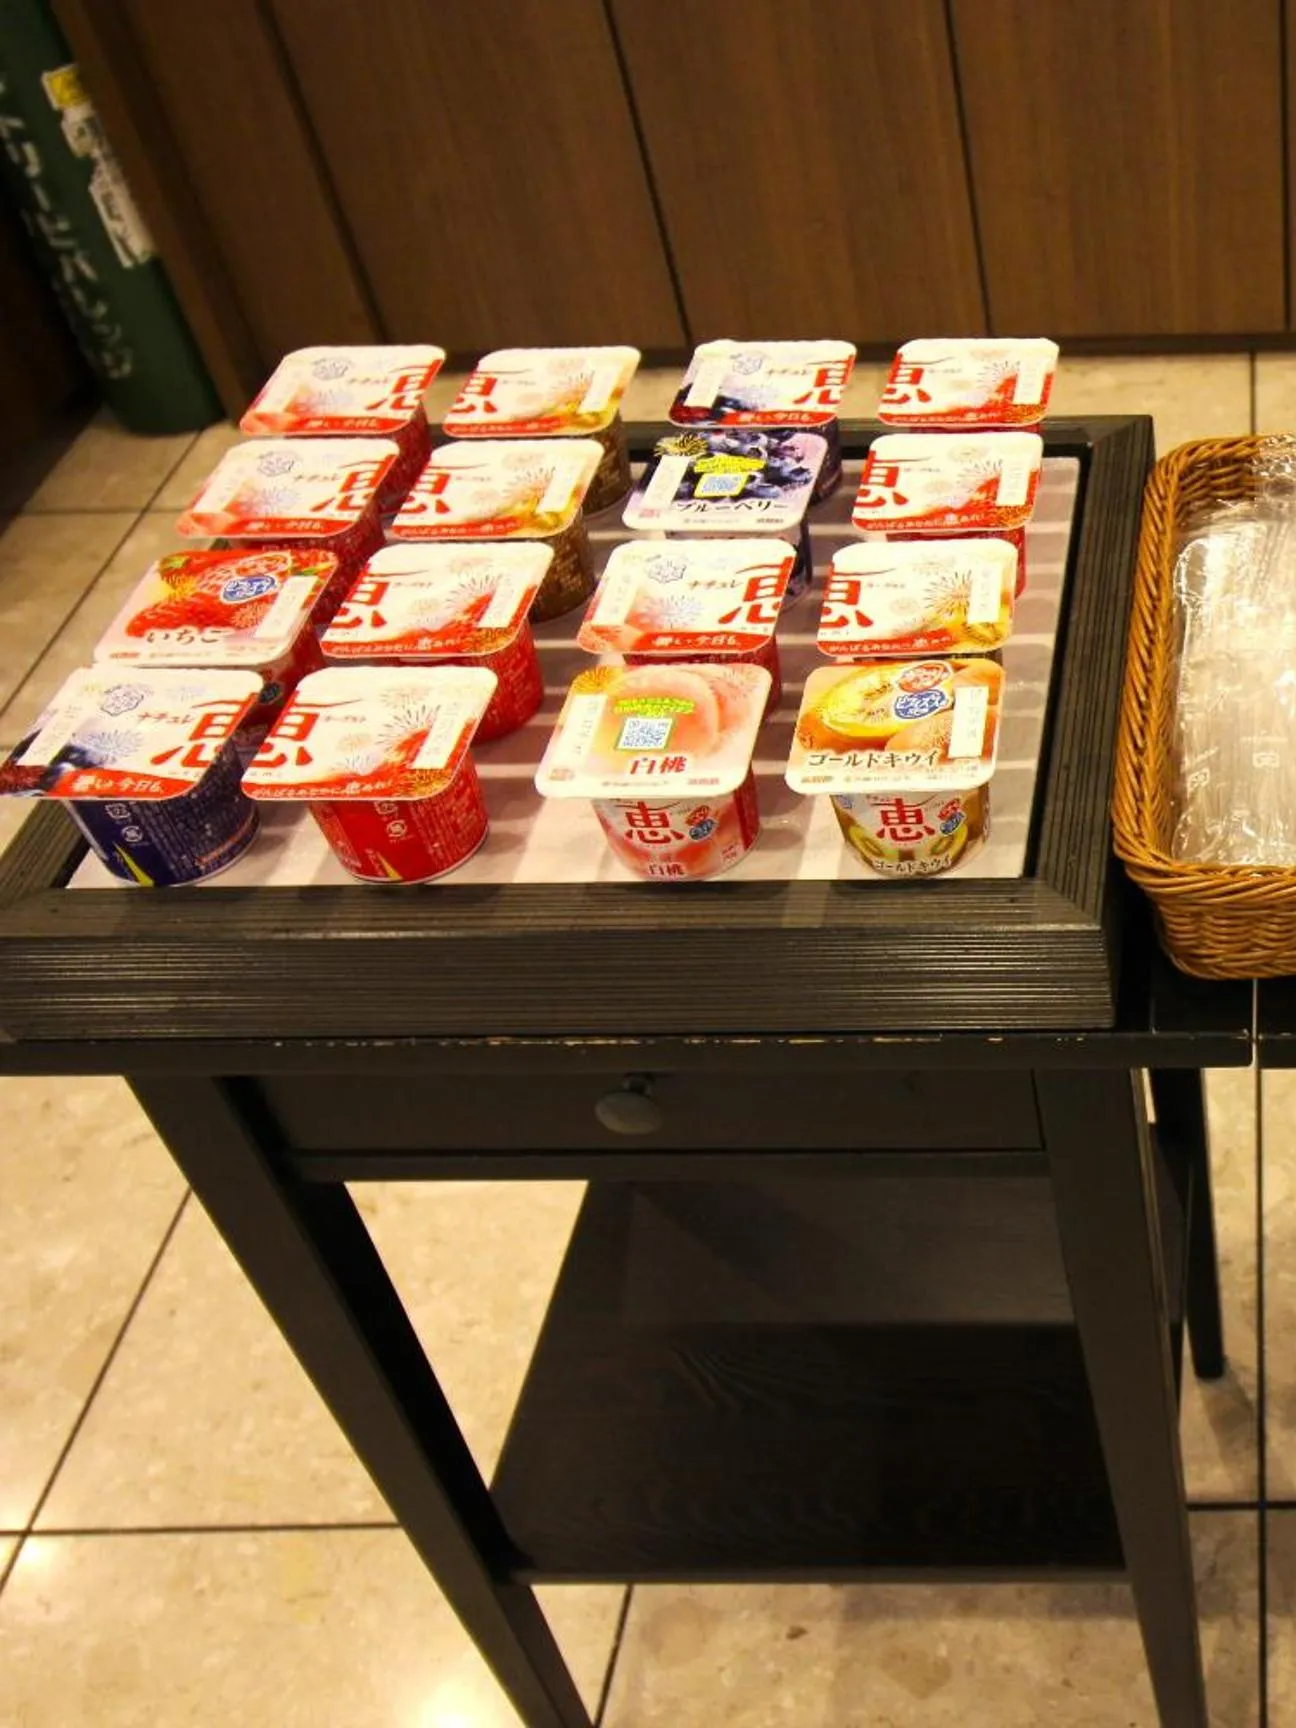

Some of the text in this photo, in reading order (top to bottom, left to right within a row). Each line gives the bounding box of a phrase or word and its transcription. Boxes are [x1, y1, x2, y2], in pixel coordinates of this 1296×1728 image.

[677, 501, 789, 512] ブルーベリー
[147, 629, 224, 645] いちご
[138, 711, 195, 724] ナチュレ
[629, 756, 687, 774] 白桃
[808, 751, 939, 768] ゴールドキウイ
[614, 801, 685, 843] 恵
[869, 795, 938, 842] 恵
[874, 857, 951, 873] ゴールドキウイ
